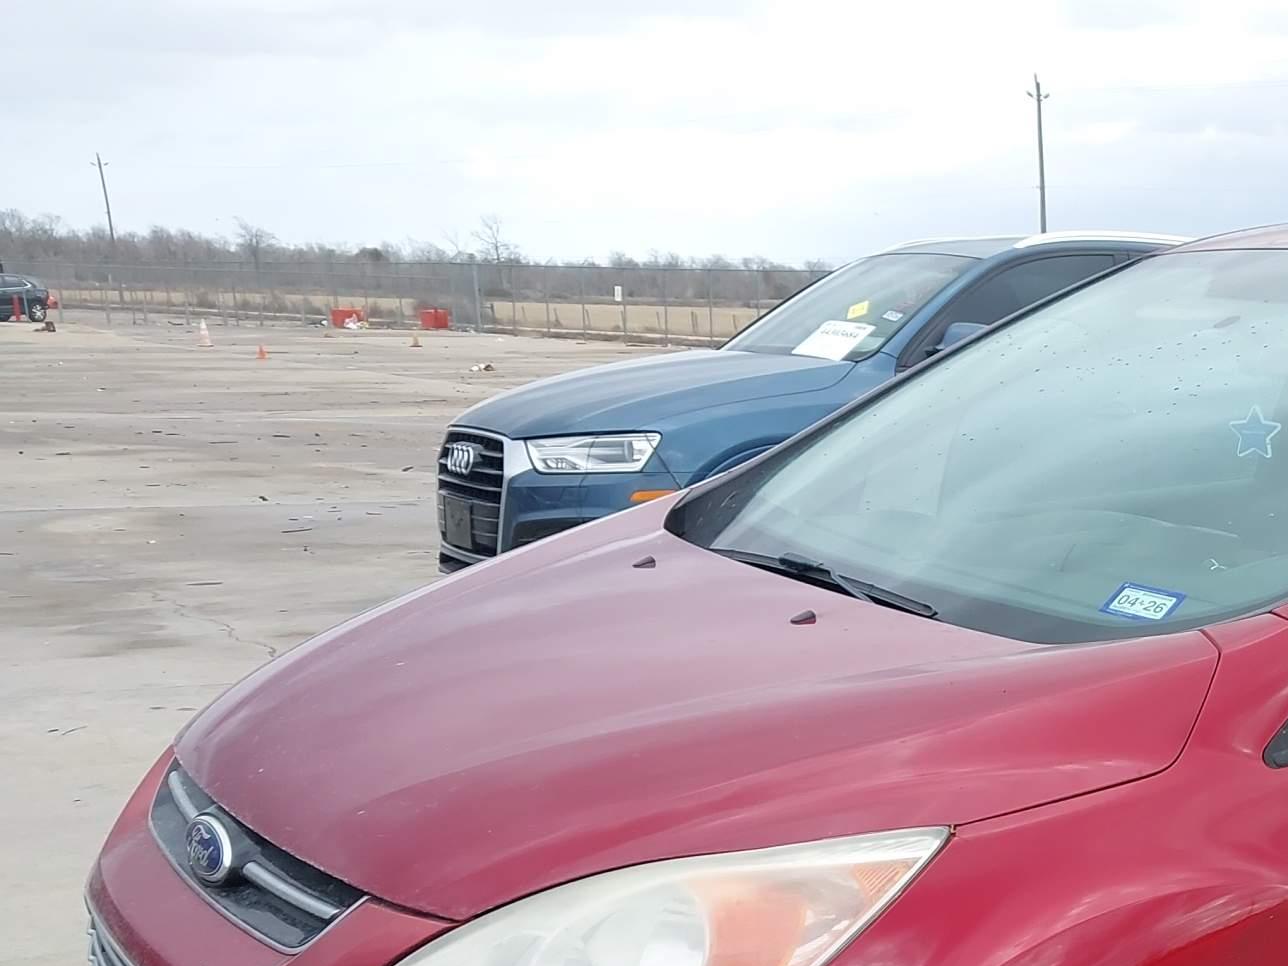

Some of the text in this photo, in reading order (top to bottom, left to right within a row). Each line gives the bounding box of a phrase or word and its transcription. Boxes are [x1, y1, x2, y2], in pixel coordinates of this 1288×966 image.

[1117, 594, 1140, 608] 04
[1143, 600, 1167, 614] 26
[187, 824, 214, 867] Ford
